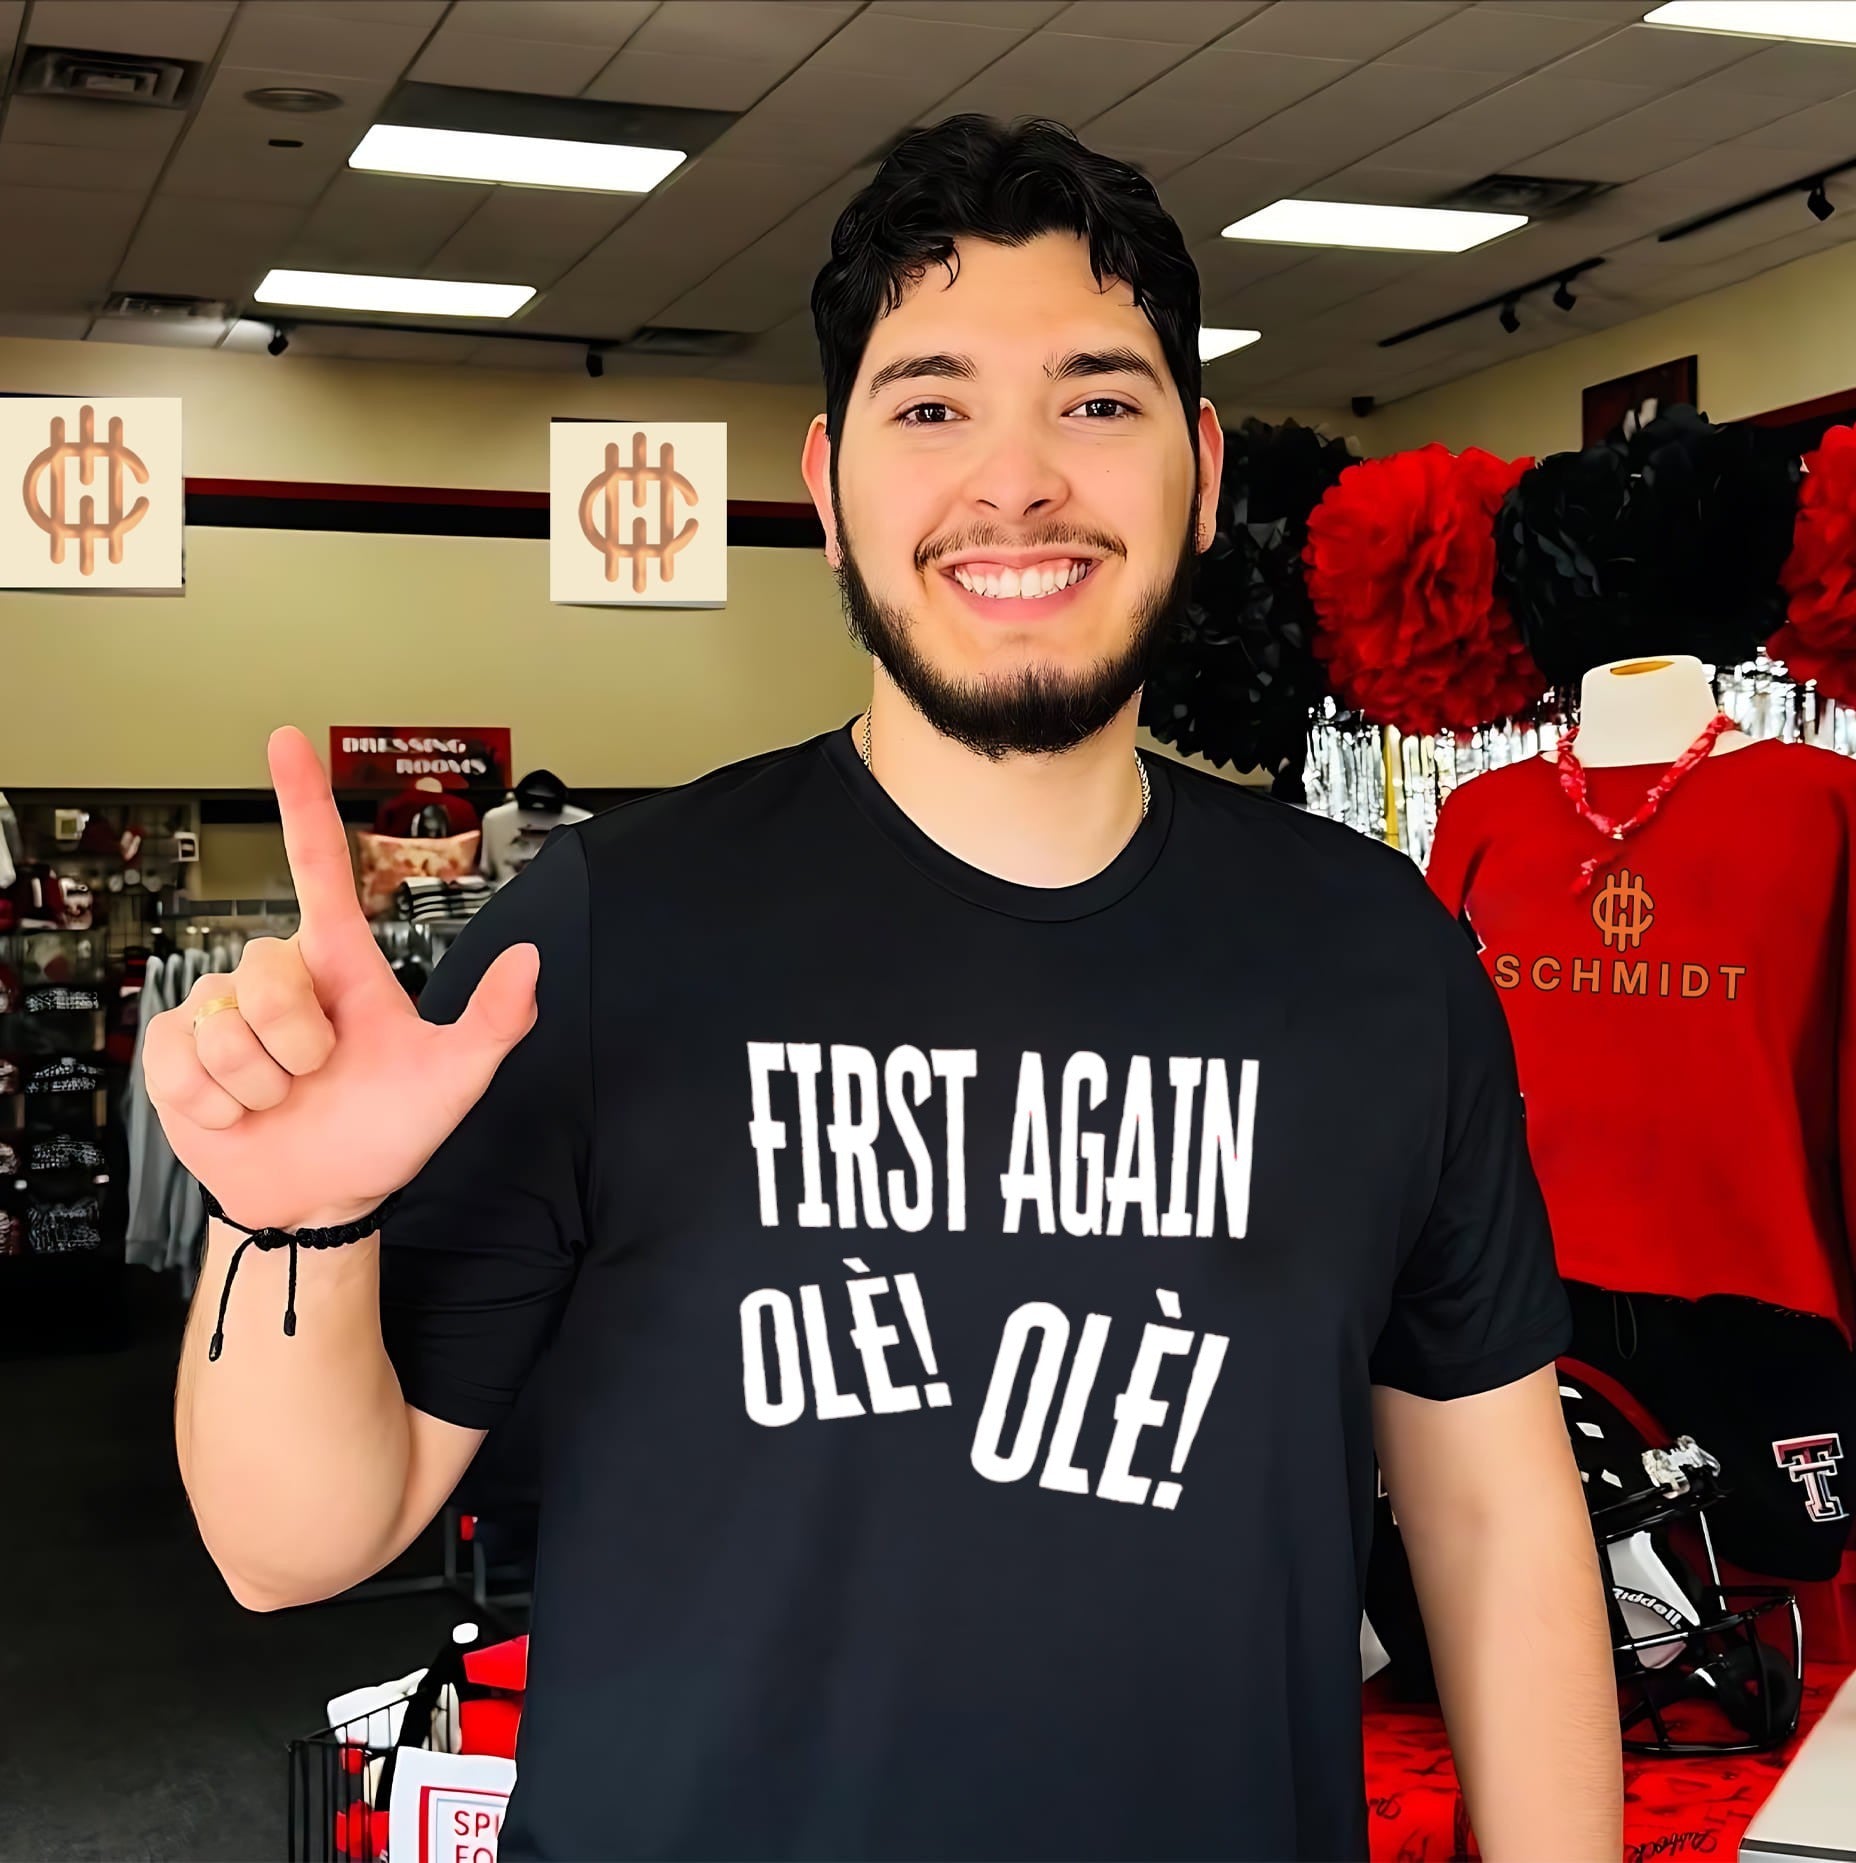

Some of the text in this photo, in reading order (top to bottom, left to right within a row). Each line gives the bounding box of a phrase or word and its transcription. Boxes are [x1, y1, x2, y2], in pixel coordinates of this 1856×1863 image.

[342, 737, 466, 753] DRESSING
[396, 759, 487, 775] ROOMS
[1495, 955, 1745, 999] SCHMIDT
[747, 1042, 1259, 1239] FIRST AGAIN
